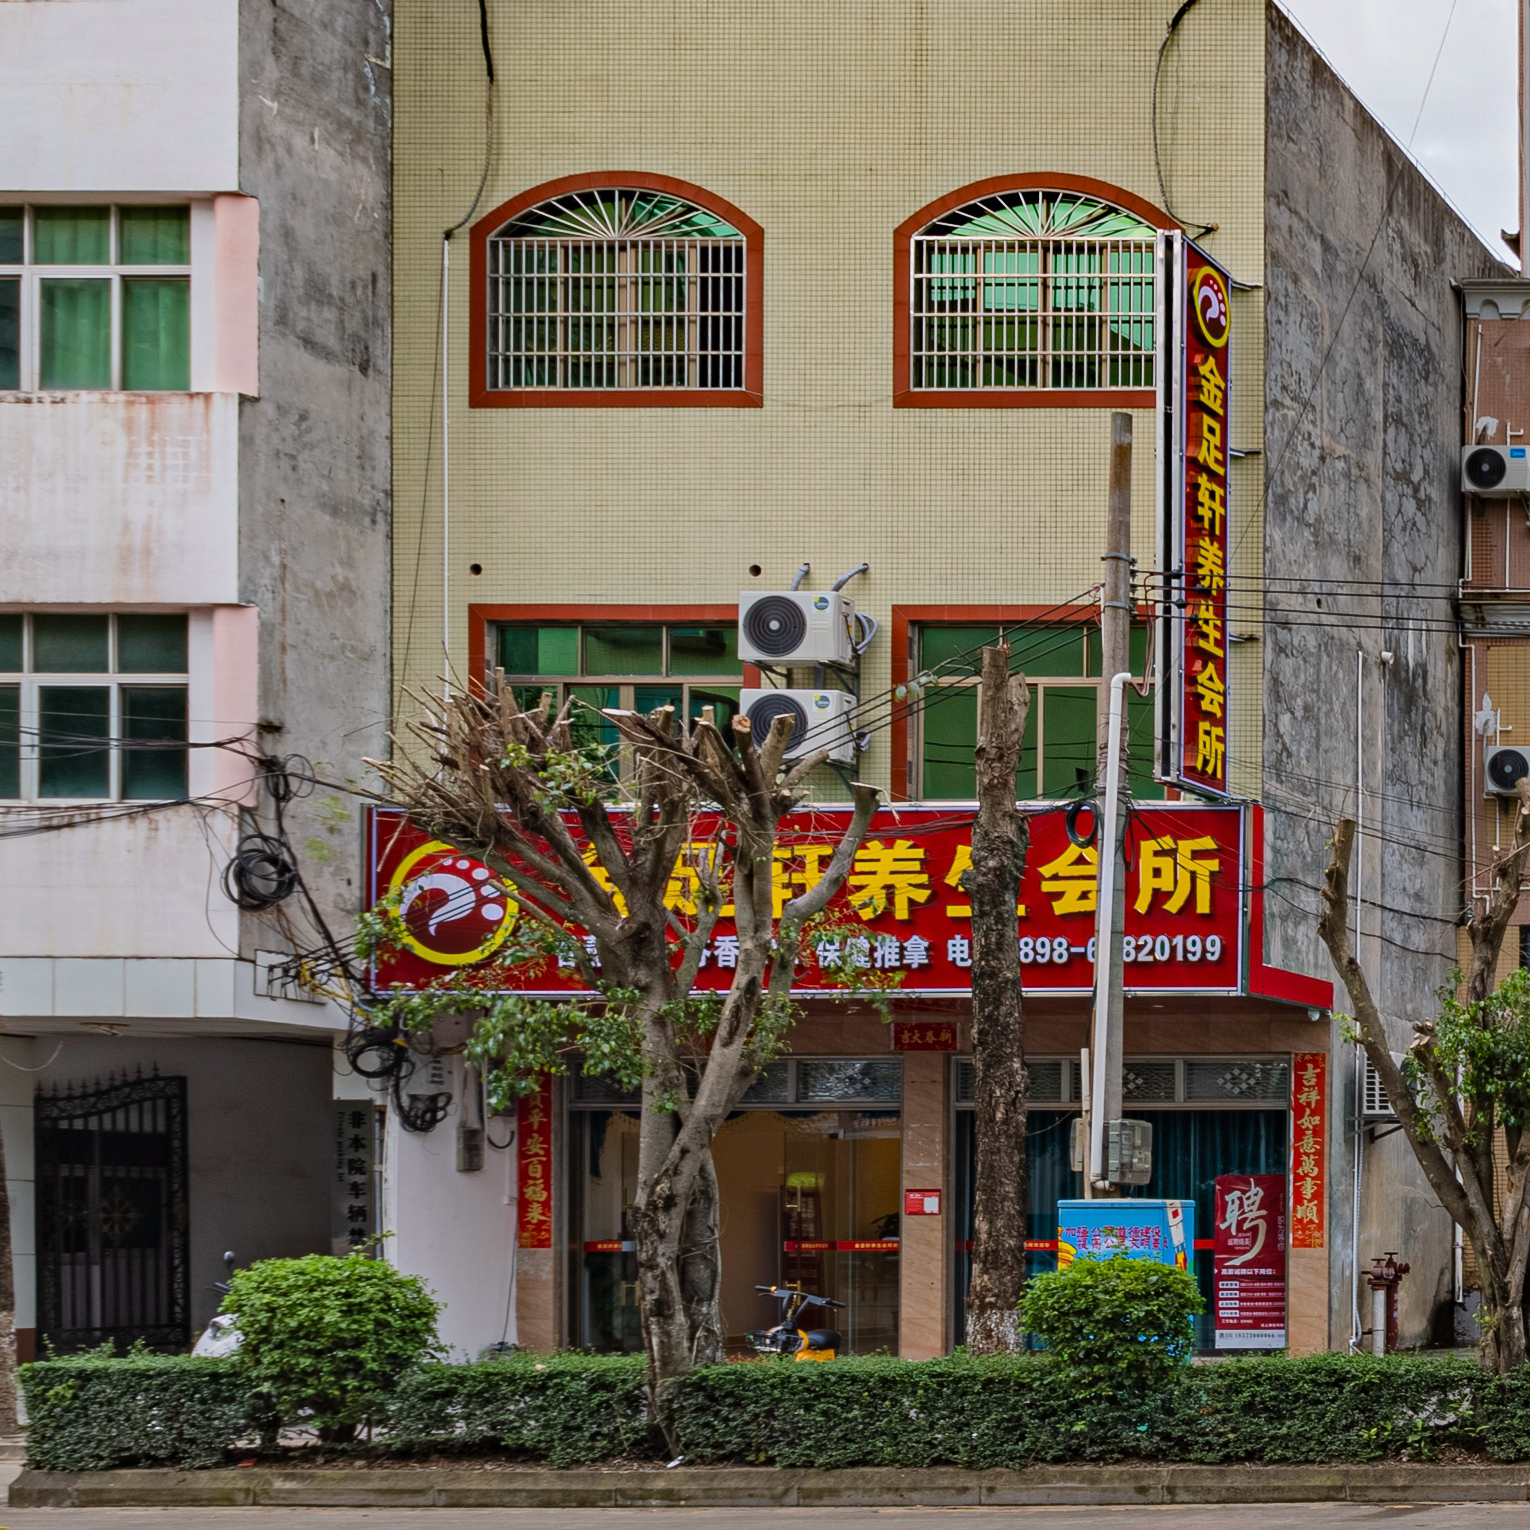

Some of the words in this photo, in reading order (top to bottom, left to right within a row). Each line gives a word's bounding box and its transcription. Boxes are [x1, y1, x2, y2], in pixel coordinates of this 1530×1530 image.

[1196, 354, 1225, 779] 金足轩养生会所
[817, 934, 930, 969] 保健推拿
[1019, 934, 1222, 964] 898-6820199
[1219, 1177, 1268, 1266] 聘
